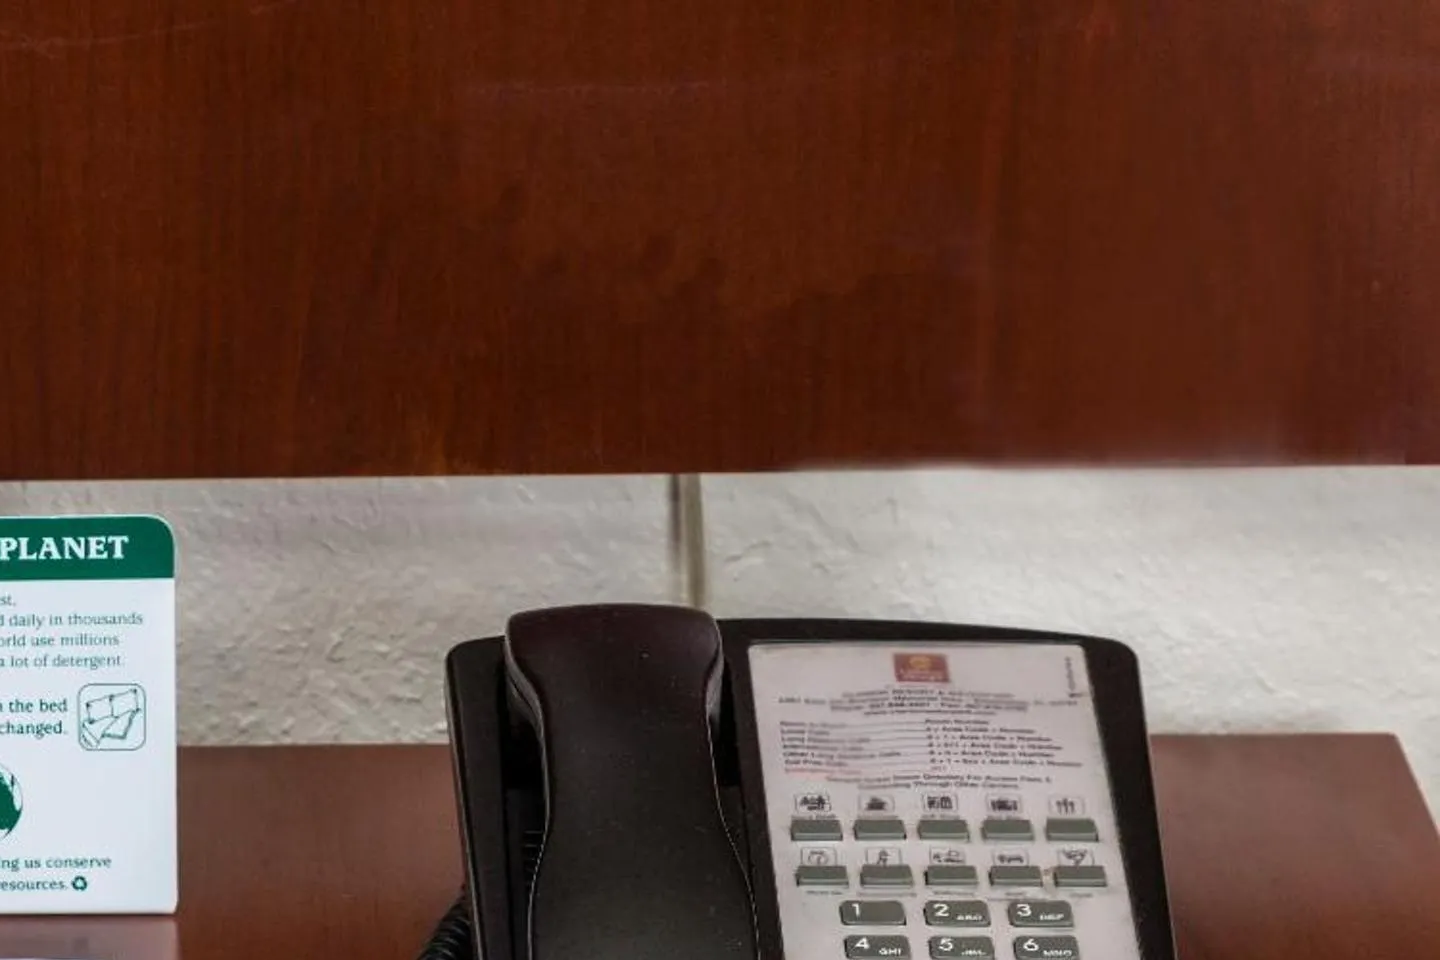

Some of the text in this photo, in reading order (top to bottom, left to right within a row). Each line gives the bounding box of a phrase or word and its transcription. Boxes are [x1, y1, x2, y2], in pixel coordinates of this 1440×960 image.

[9, 614, 45, 630] daily
[48, 614, 63, 626] in
[68, 612, 144, 626] thousands
[31, 636, 56, 647] use
[60, 633, 120, 647] millions
[10, 655, 29, 669] lot
[33, 654, 50, 668] of
[8, 699, 34, 713] the
[39, 698, 68, 713] bed
[24, 859, 42, 869] us
[45, 857, 113, 869] conserve
[851, 903, 861, 917] 1
[933, 903, 949, 917] 2
[1016, 903, 1032, 917] 3
[854, 937, 902, 956] 4 GHI
[938, 938, 954, 951] 5
[1023, 938, 1039, 951] 6
